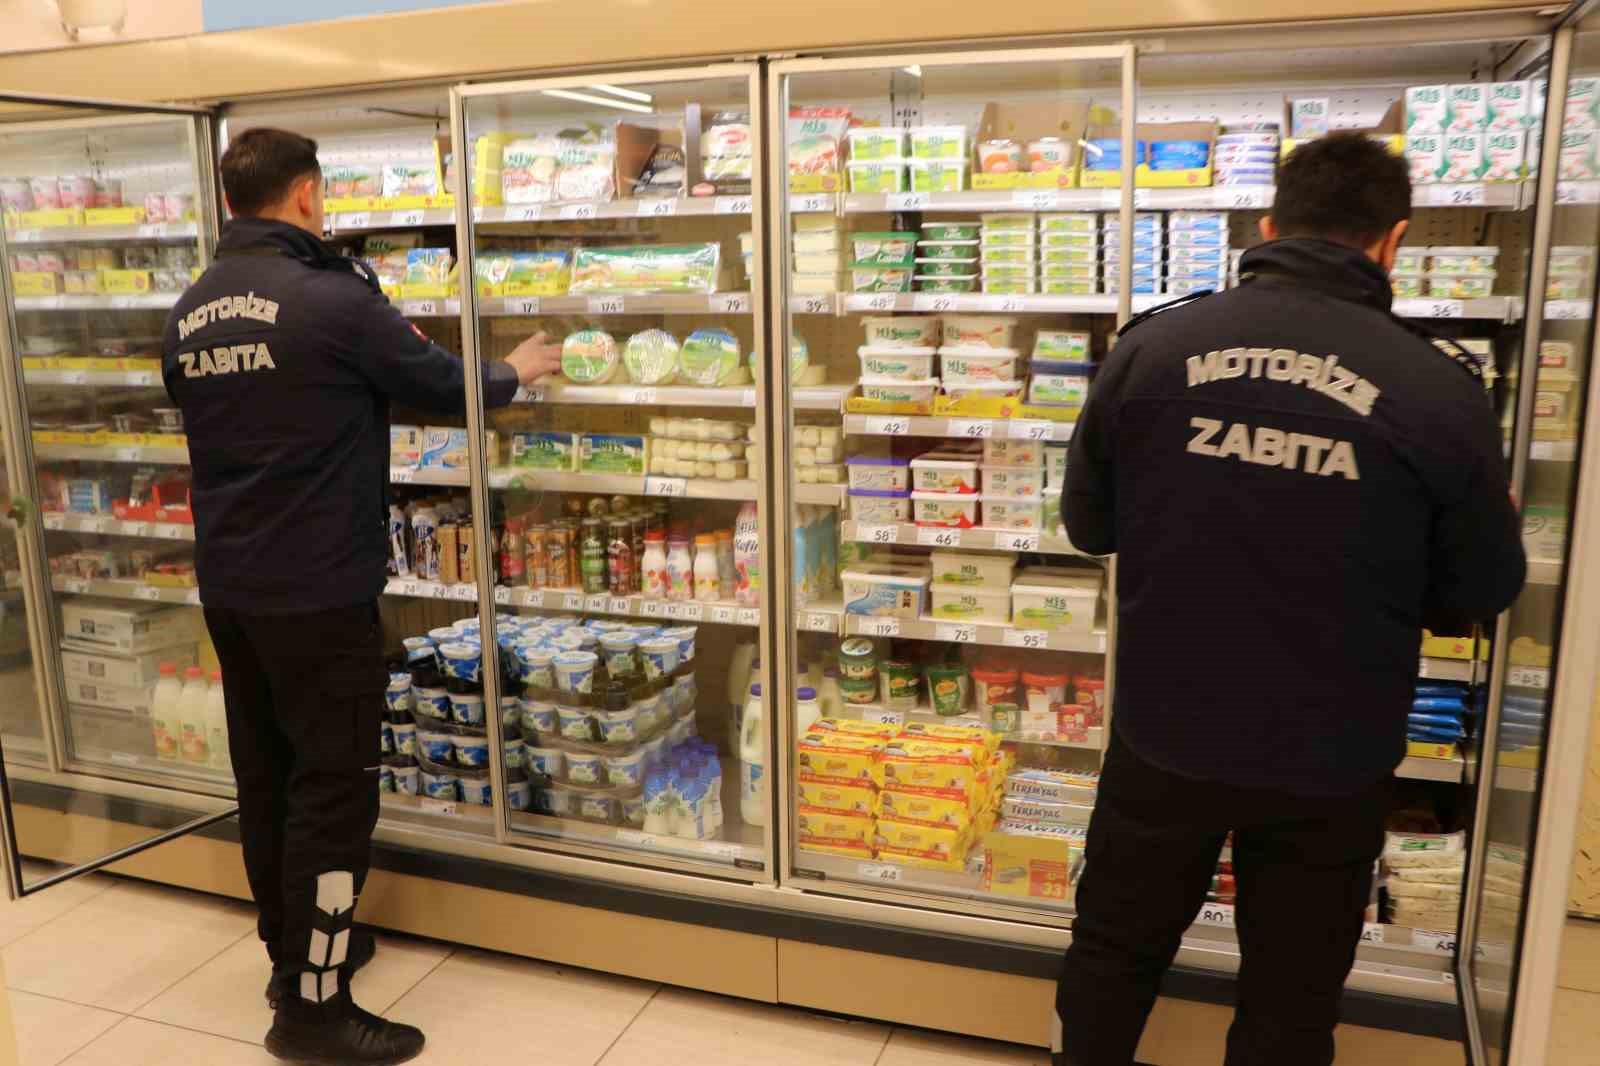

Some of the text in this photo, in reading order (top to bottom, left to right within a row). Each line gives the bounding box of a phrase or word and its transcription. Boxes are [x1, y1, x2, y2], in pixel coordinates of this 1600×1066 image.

[806, 300, 821, 312] 39
[179, 343, 276, 378] ZABITA
[1186, 348, 1381, 417] MOTORİZE
[884, 422, 900, 433] 42
[967, 424, 983, 436] 42
[1030, 427, 1045, 439] 57
[1186, 417, 1360, 481] ZABITA
[659, 484, 673, 494] 74
[874, 530, 889, 541] 58
[936, 534, 952, 545] 46
[1012, 537, 1030, 549] 46
[876, 625, 891, 636] 119
[954, 630, 969, 641] 75
[1023, 635, 1039, 647] 95
